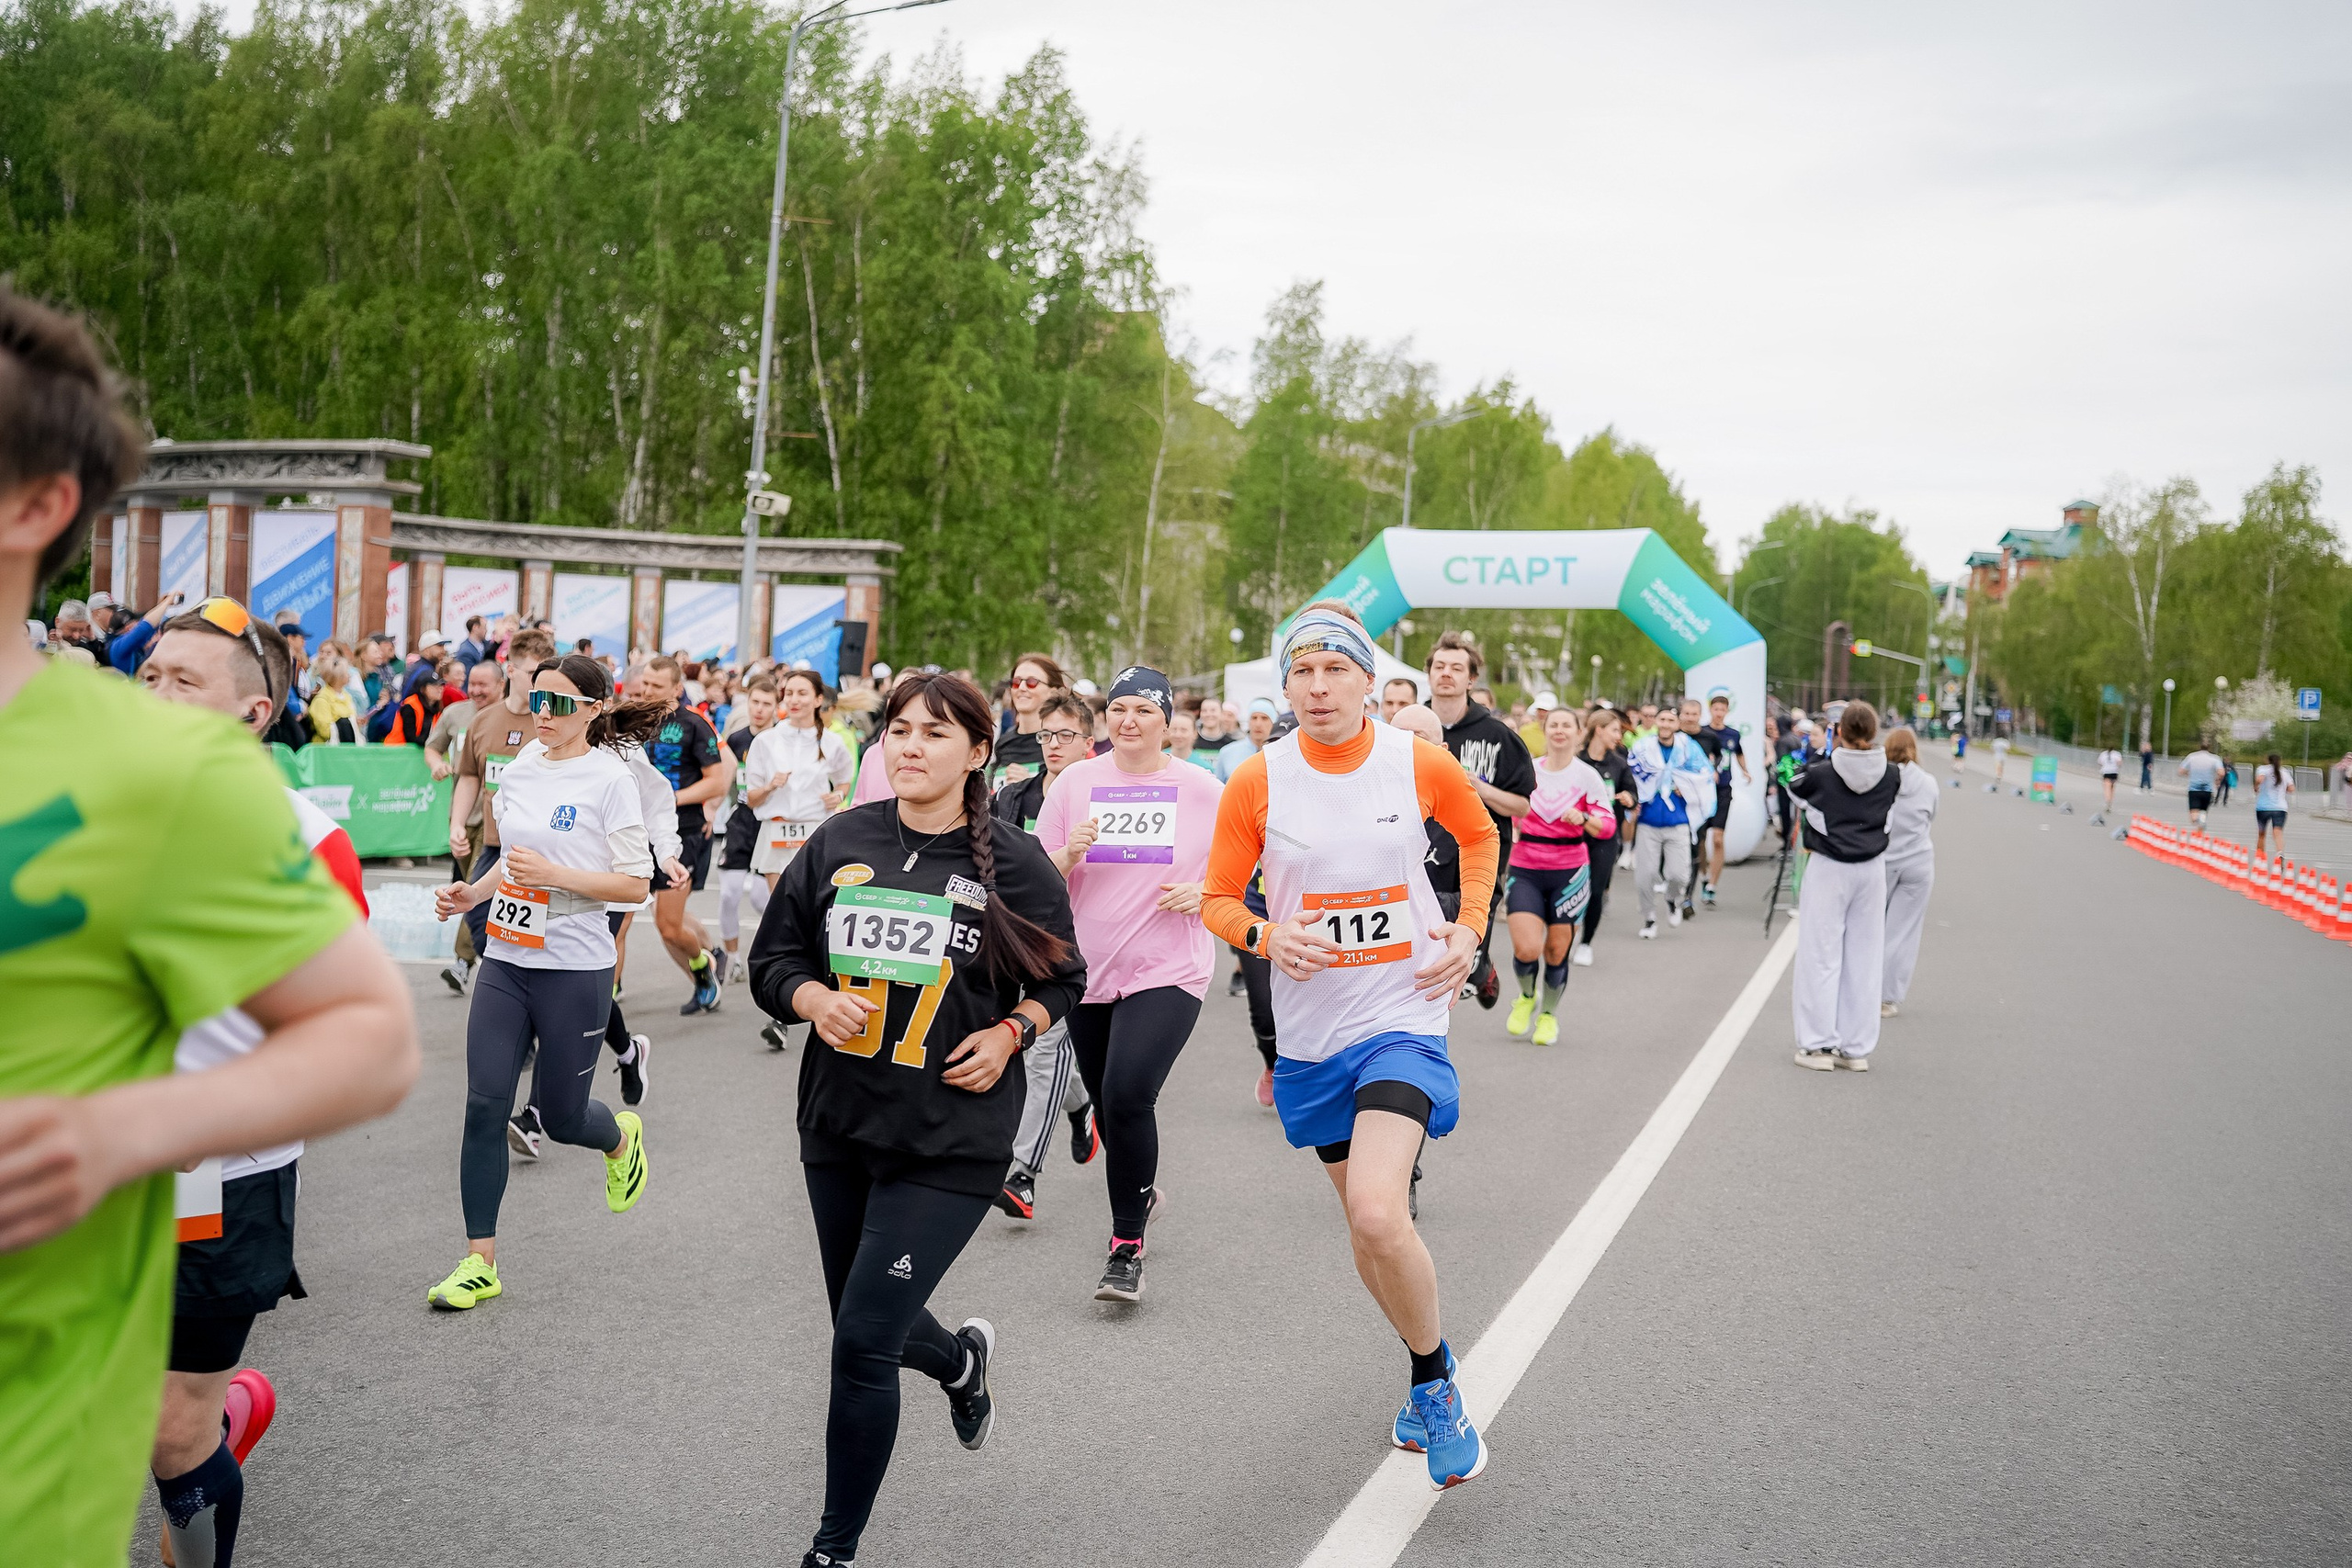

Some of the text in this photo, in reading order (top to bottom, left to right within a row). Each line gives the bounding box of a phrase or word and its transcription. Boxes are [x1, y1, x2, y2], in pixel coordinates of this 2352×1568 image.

[1442, 556, 1578, 585] СТАРТ
[2305, 691, 2317, 708] P
[781, 825, 805, 837] 151
[1101, 812, 1166, 834] 2269
[948, 877, 989, 905] FREEDOM
[496, 898, 532, 929] 292
[1328, 910, 1390, 944] 112
[842, 913, 934, 956] 1352
